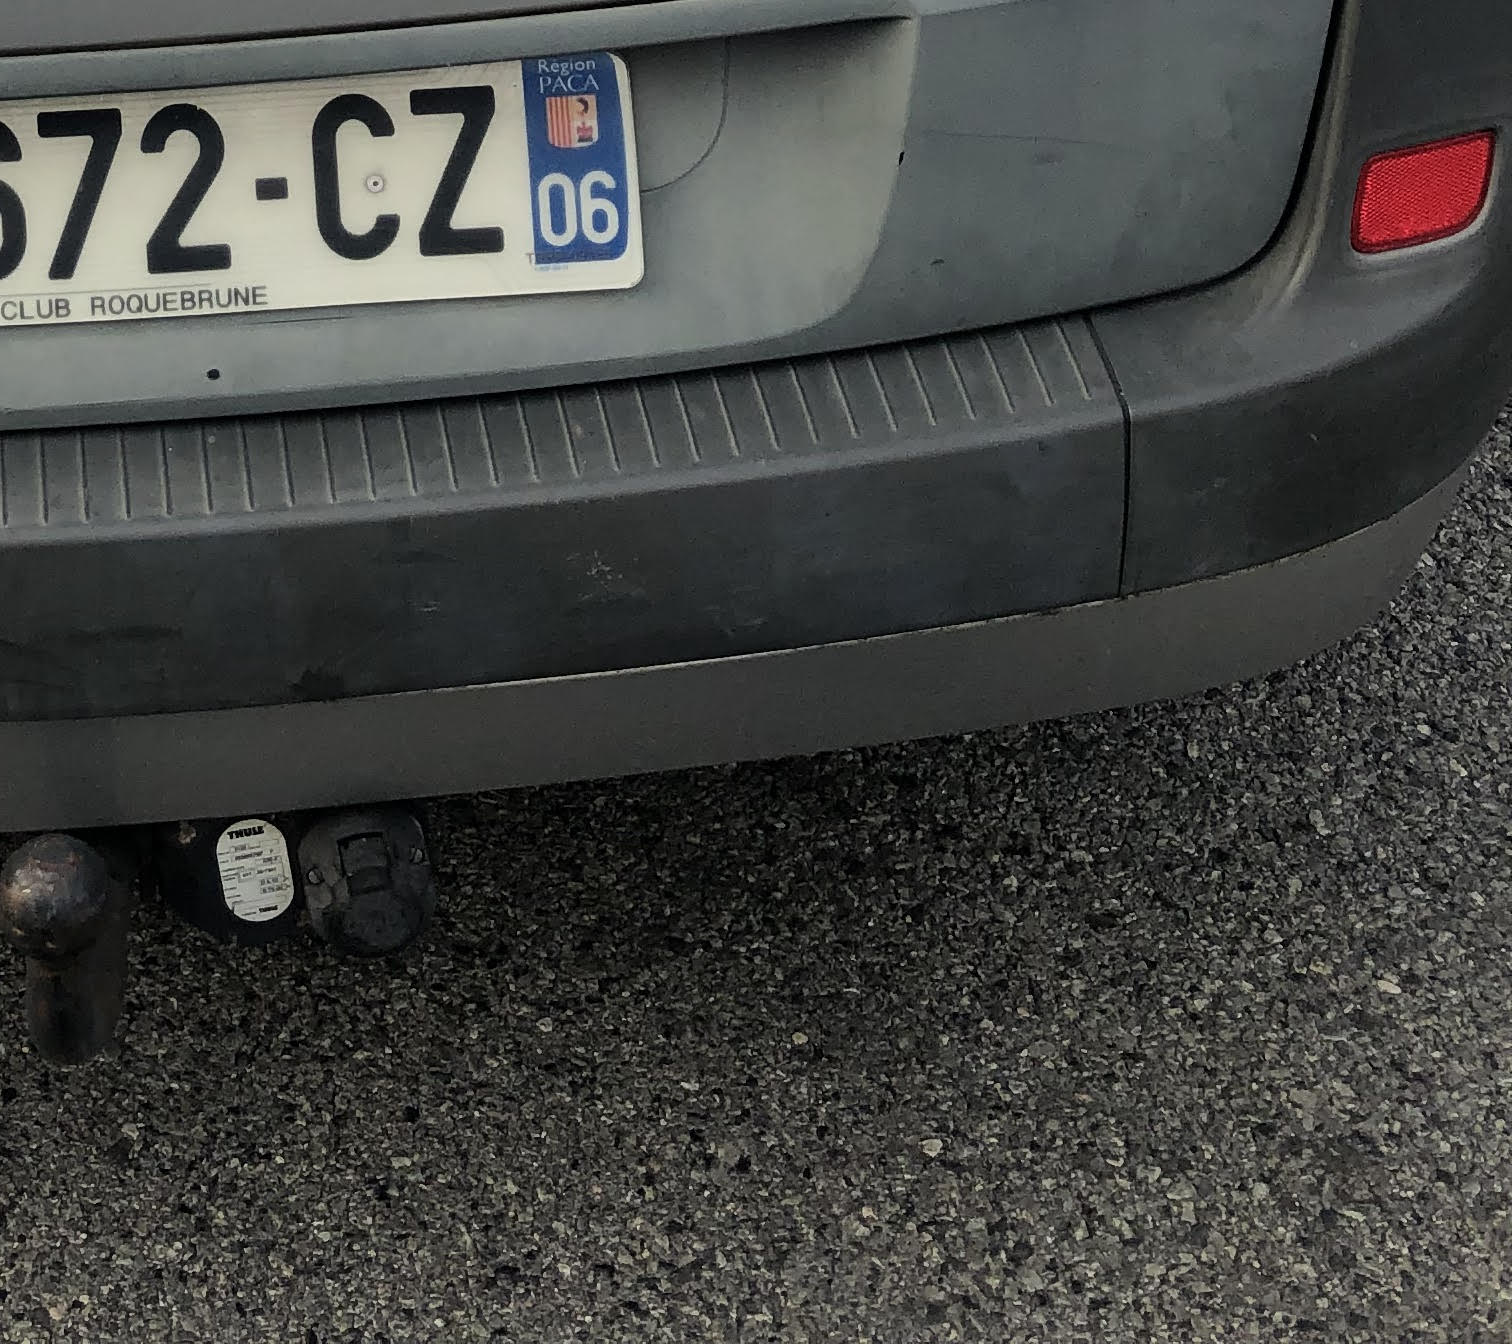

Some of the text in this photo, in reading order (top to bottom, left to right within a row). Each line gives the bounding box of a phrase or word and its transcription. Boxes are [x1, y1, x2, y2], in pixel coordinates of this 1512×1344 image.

[538, 59, 596, 76] Région
[539, 74, 600, 94] PACA
[538, 170, 620, 247] 06
[0, 297, 72, 321] CLUB
[90, 285, 269, 317] ROQUEBRUNE
[227, 825, 265, 840] THULE
